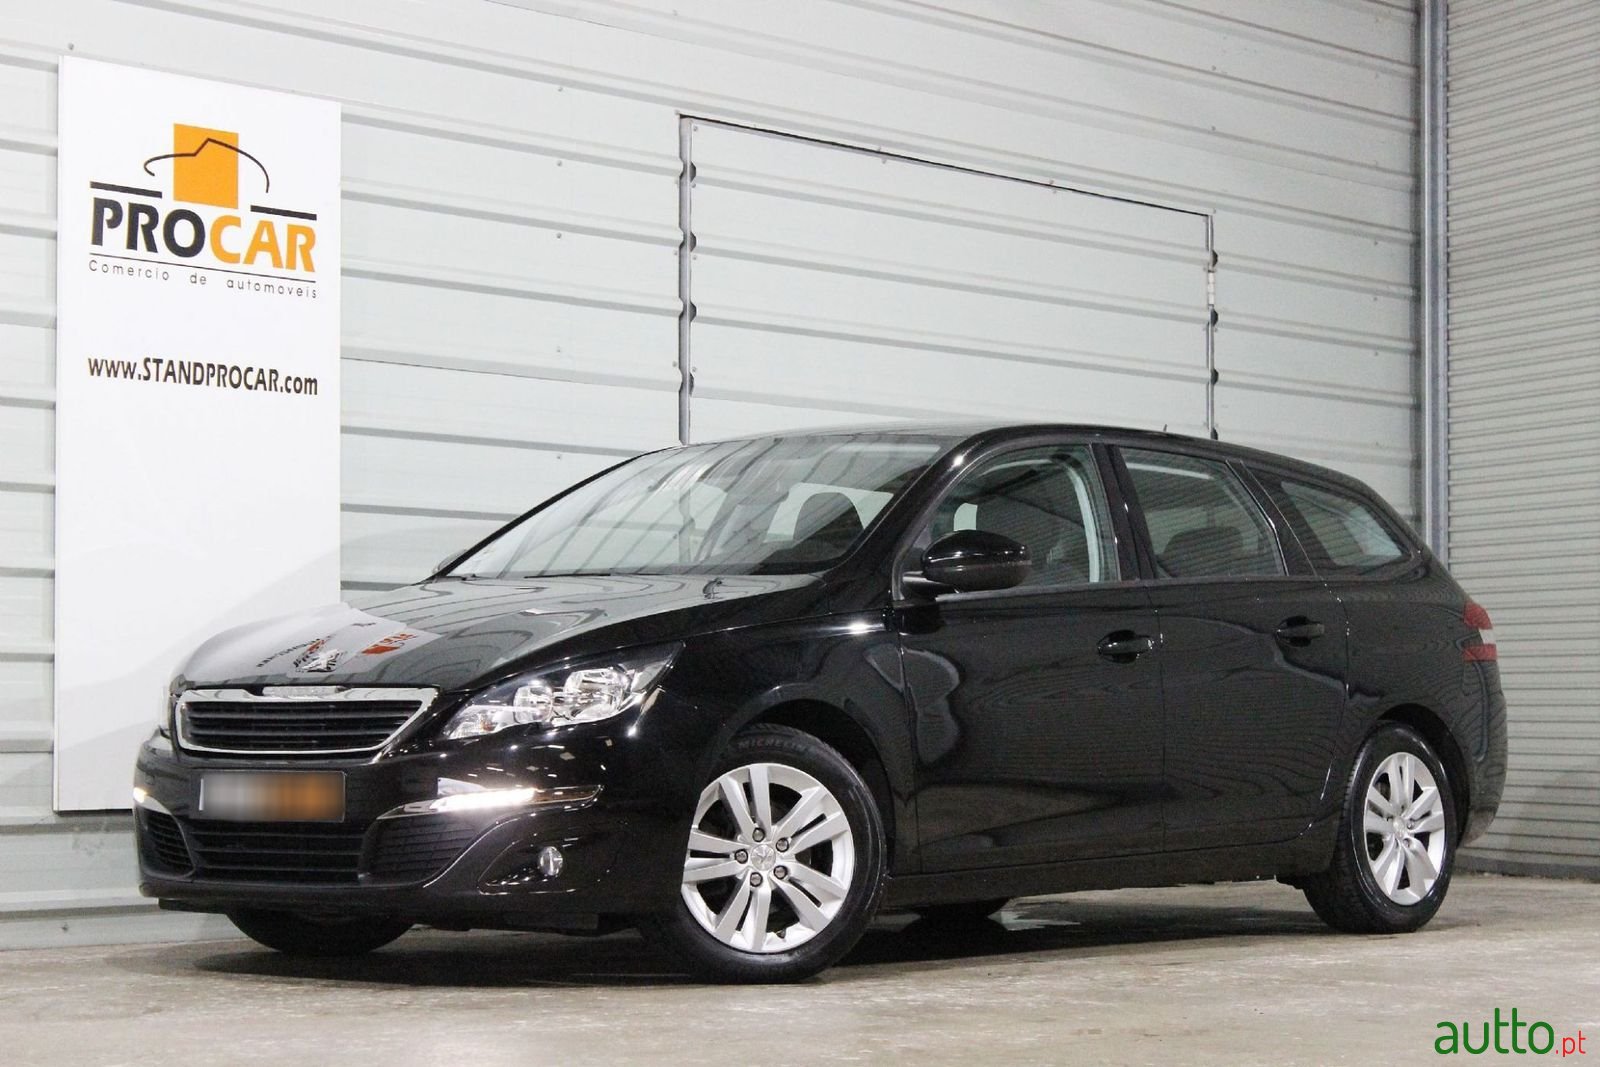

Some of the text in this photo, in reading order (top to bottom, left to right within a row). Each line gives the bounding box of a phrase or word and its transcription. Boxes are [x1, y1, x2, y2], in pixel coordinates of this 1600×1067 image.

[91, 197, 316, 273] PROCAR
[89, 259, 317, 299] Comercio de automoveis
[88, 357, 318, 396] www.STANDPROCAR.com
